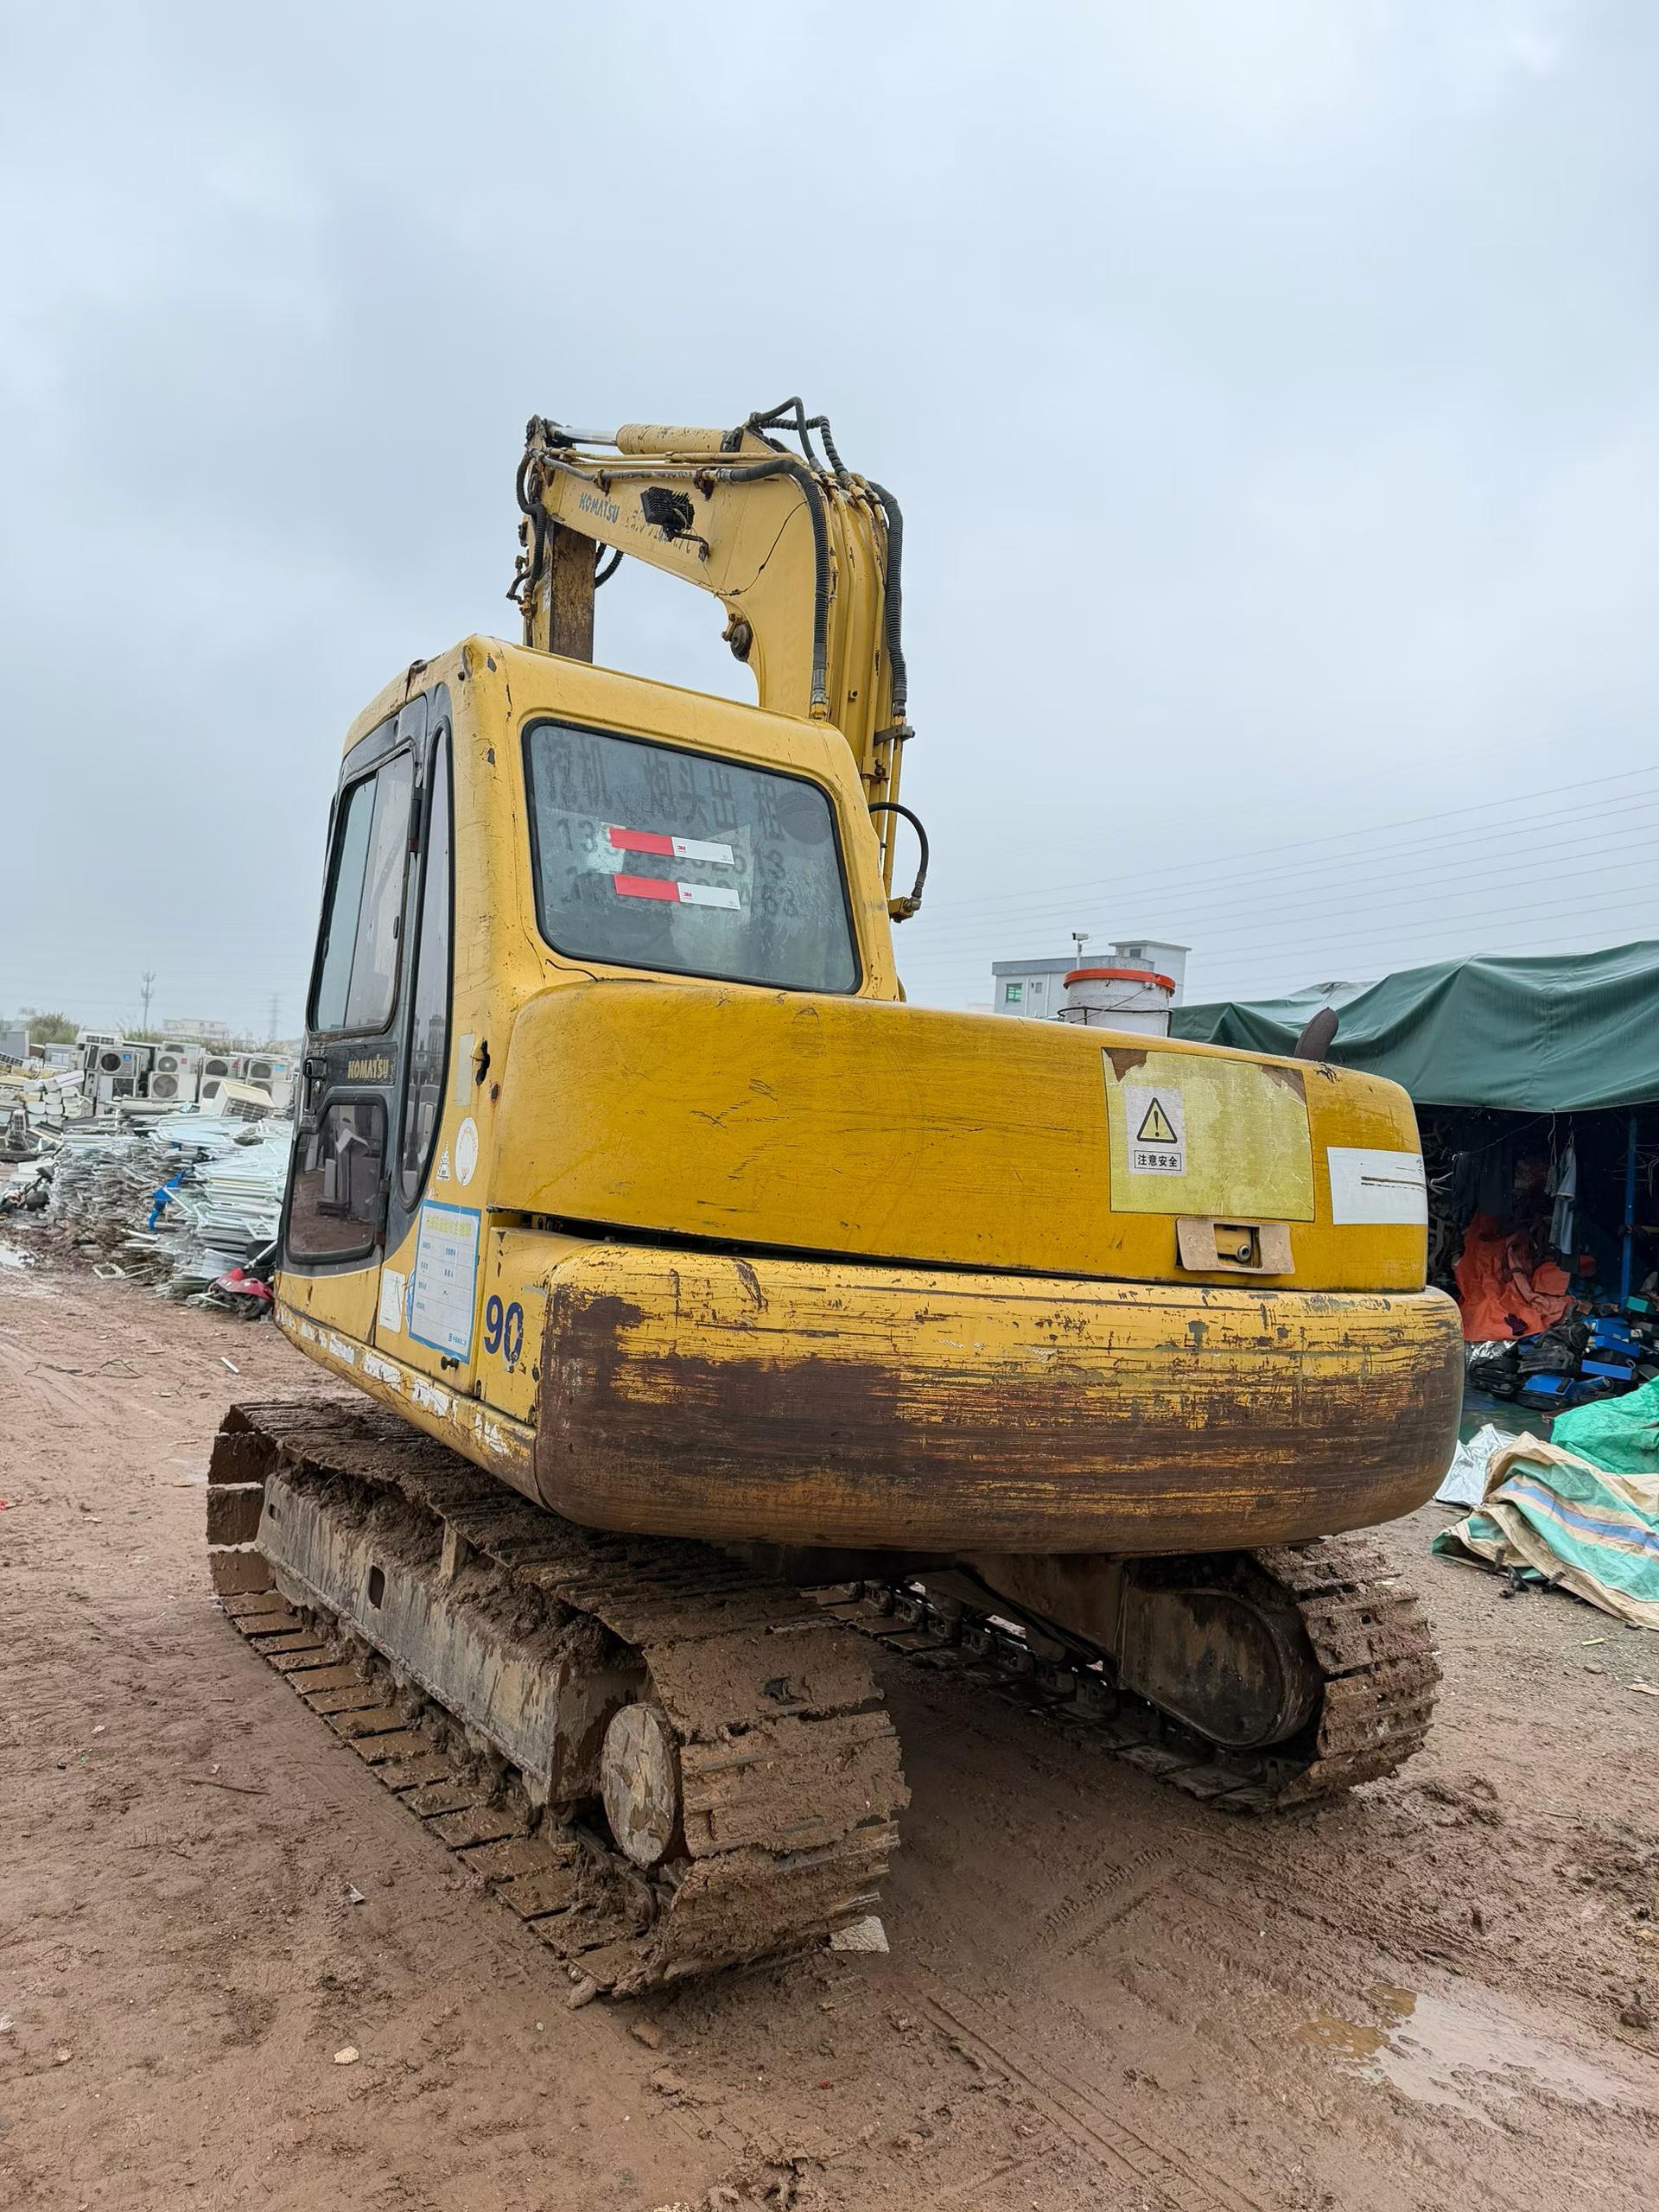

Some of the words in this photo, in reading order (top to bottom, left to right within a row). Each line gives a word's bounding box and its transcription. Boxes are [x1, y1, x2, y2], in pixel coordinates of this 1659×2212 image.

[579, 492, 620, 524] KOMATSU
[347, 1053, 389, 1079] KOMATSU
[1137, 1154, 1178, 1167] 注意安全
[484, 1294, 524, 1363] 90
